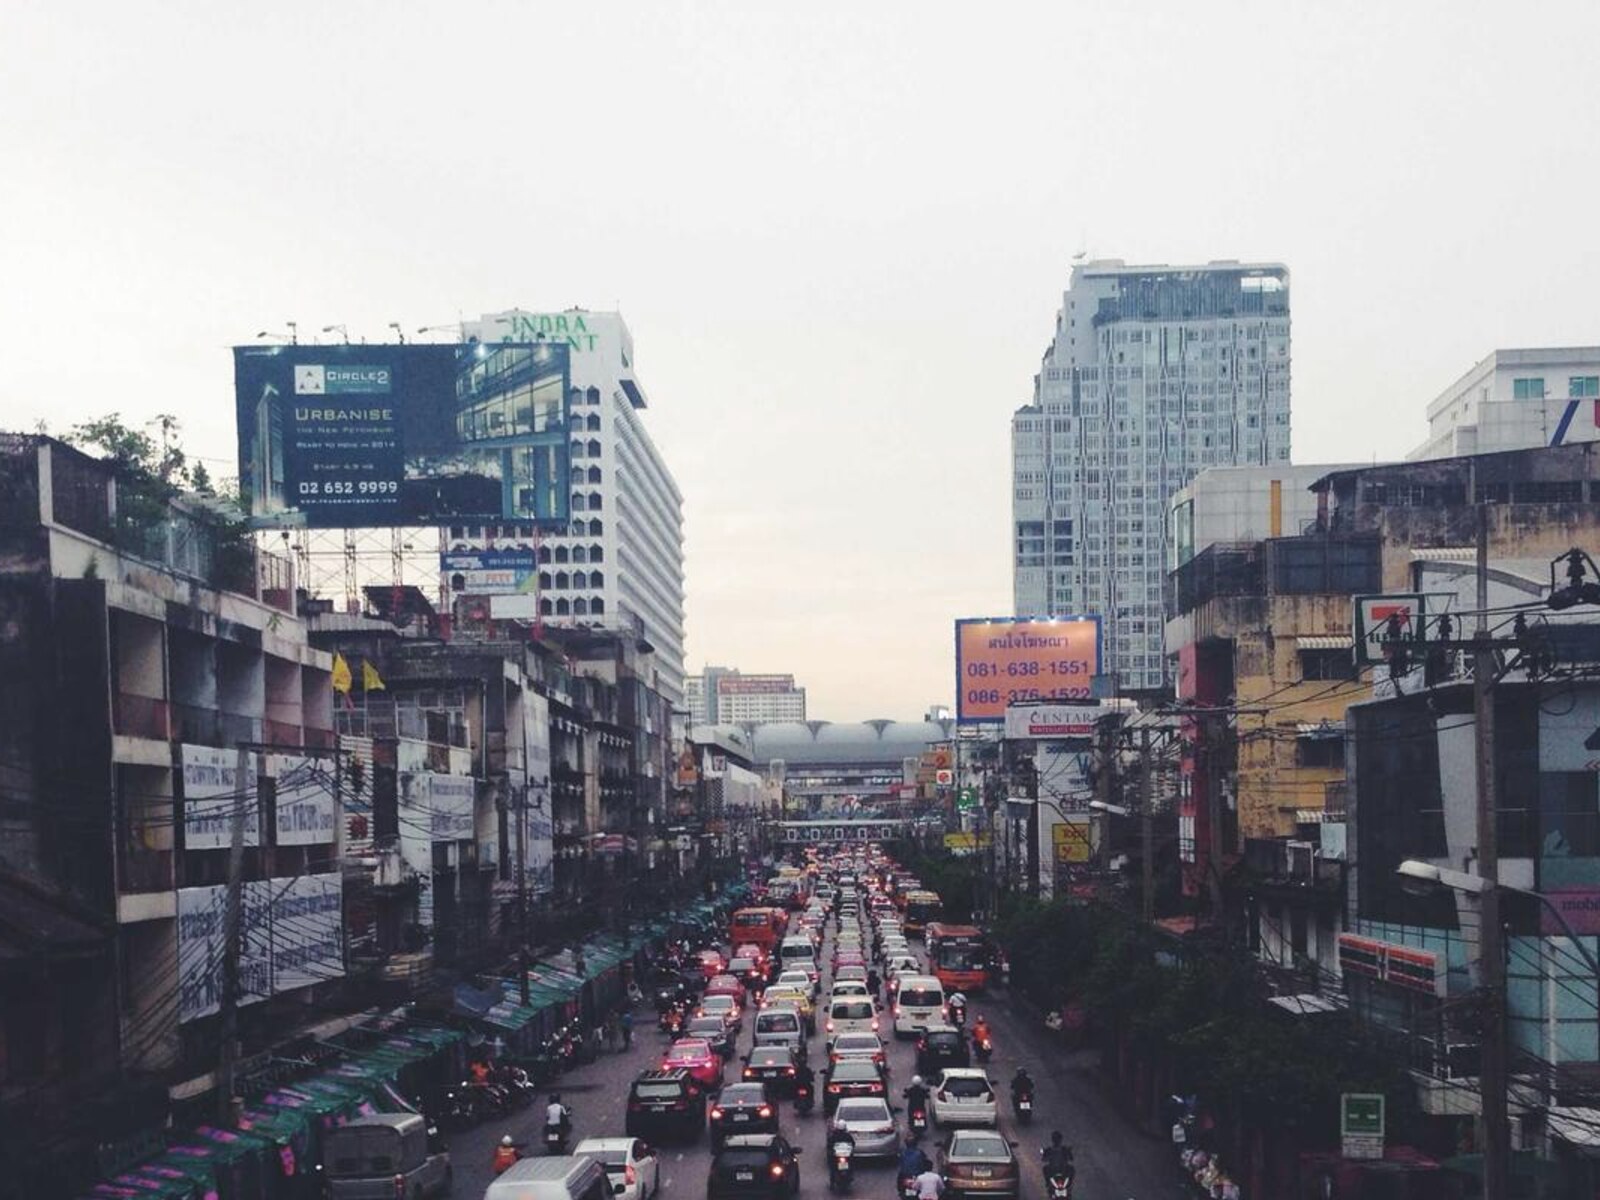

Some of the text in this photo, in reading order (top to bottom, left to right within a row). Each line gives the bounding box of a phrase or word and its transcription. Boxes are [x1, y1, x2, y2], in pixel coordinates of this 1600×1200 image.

[511, 314, 587, 333] INDRA
[295, 407, 393, 421] URBANISE
[299, 481, 398, 494] 02 652 9999
[967, 660, 1090, 677] 081-638-1551
